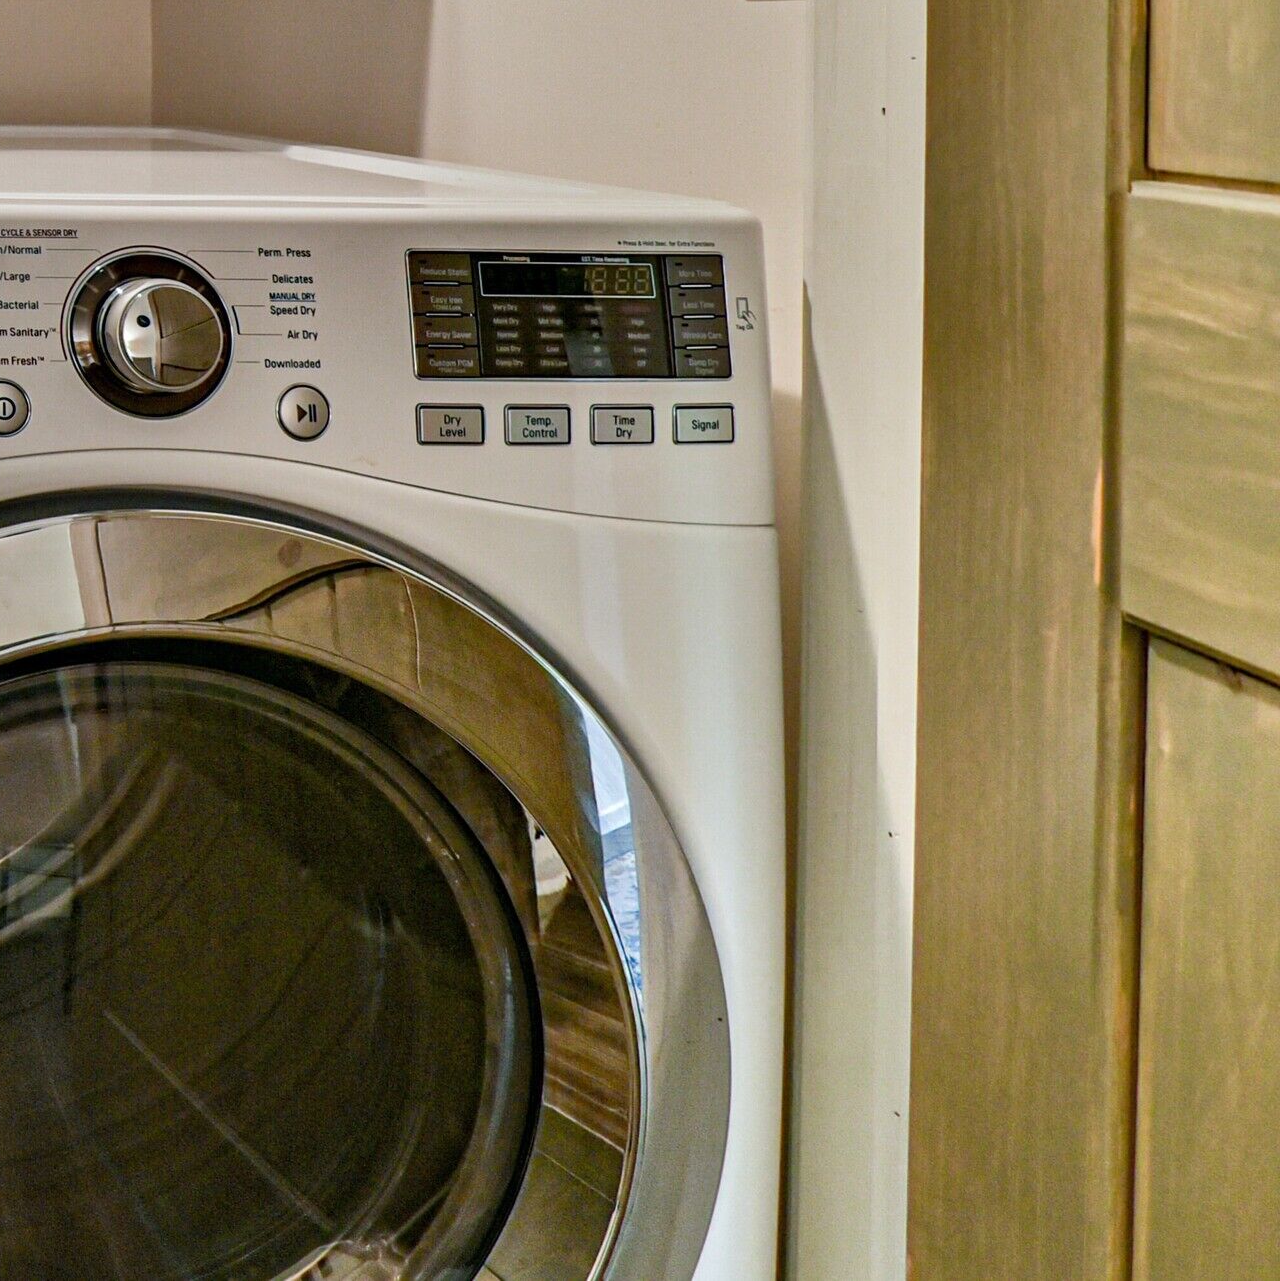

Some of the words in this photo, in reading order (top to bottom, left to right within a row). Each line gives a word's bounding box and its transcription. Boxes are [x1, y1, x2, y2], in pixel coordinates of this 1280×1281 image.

[1, 229, 24, 237] CYCLE
[25, 229, 31, 237] &
[32, 229, 62, 237] SENSOR
[63, 229, 78, 237] DRY
[258, 248, 283, 257] Perm.
[286, 248, 311, 257] Press
[272, 274, 314, 284] Delicates
[269, 292, 299, 300] MANUAL
[301, 292, 316, 300] DRY
[270, 306, 298, 316] Speed
[300, 306, 316, 316] Dry
[287, 330, 300, 339] Air
[302, 330, 318, 341] Dry
[264, 358, 321, 368] Downloaded
[444, 414, 461, 426] Dry
[525, 416, 554, 428] Temp.
[613, 415, 635, 426] Time
[692, 420, 720, 431] Signal
[439, 427, 466, 438] Level
[522, 428, 558, 438] Control
[616, 428, 633, 440] Dry
